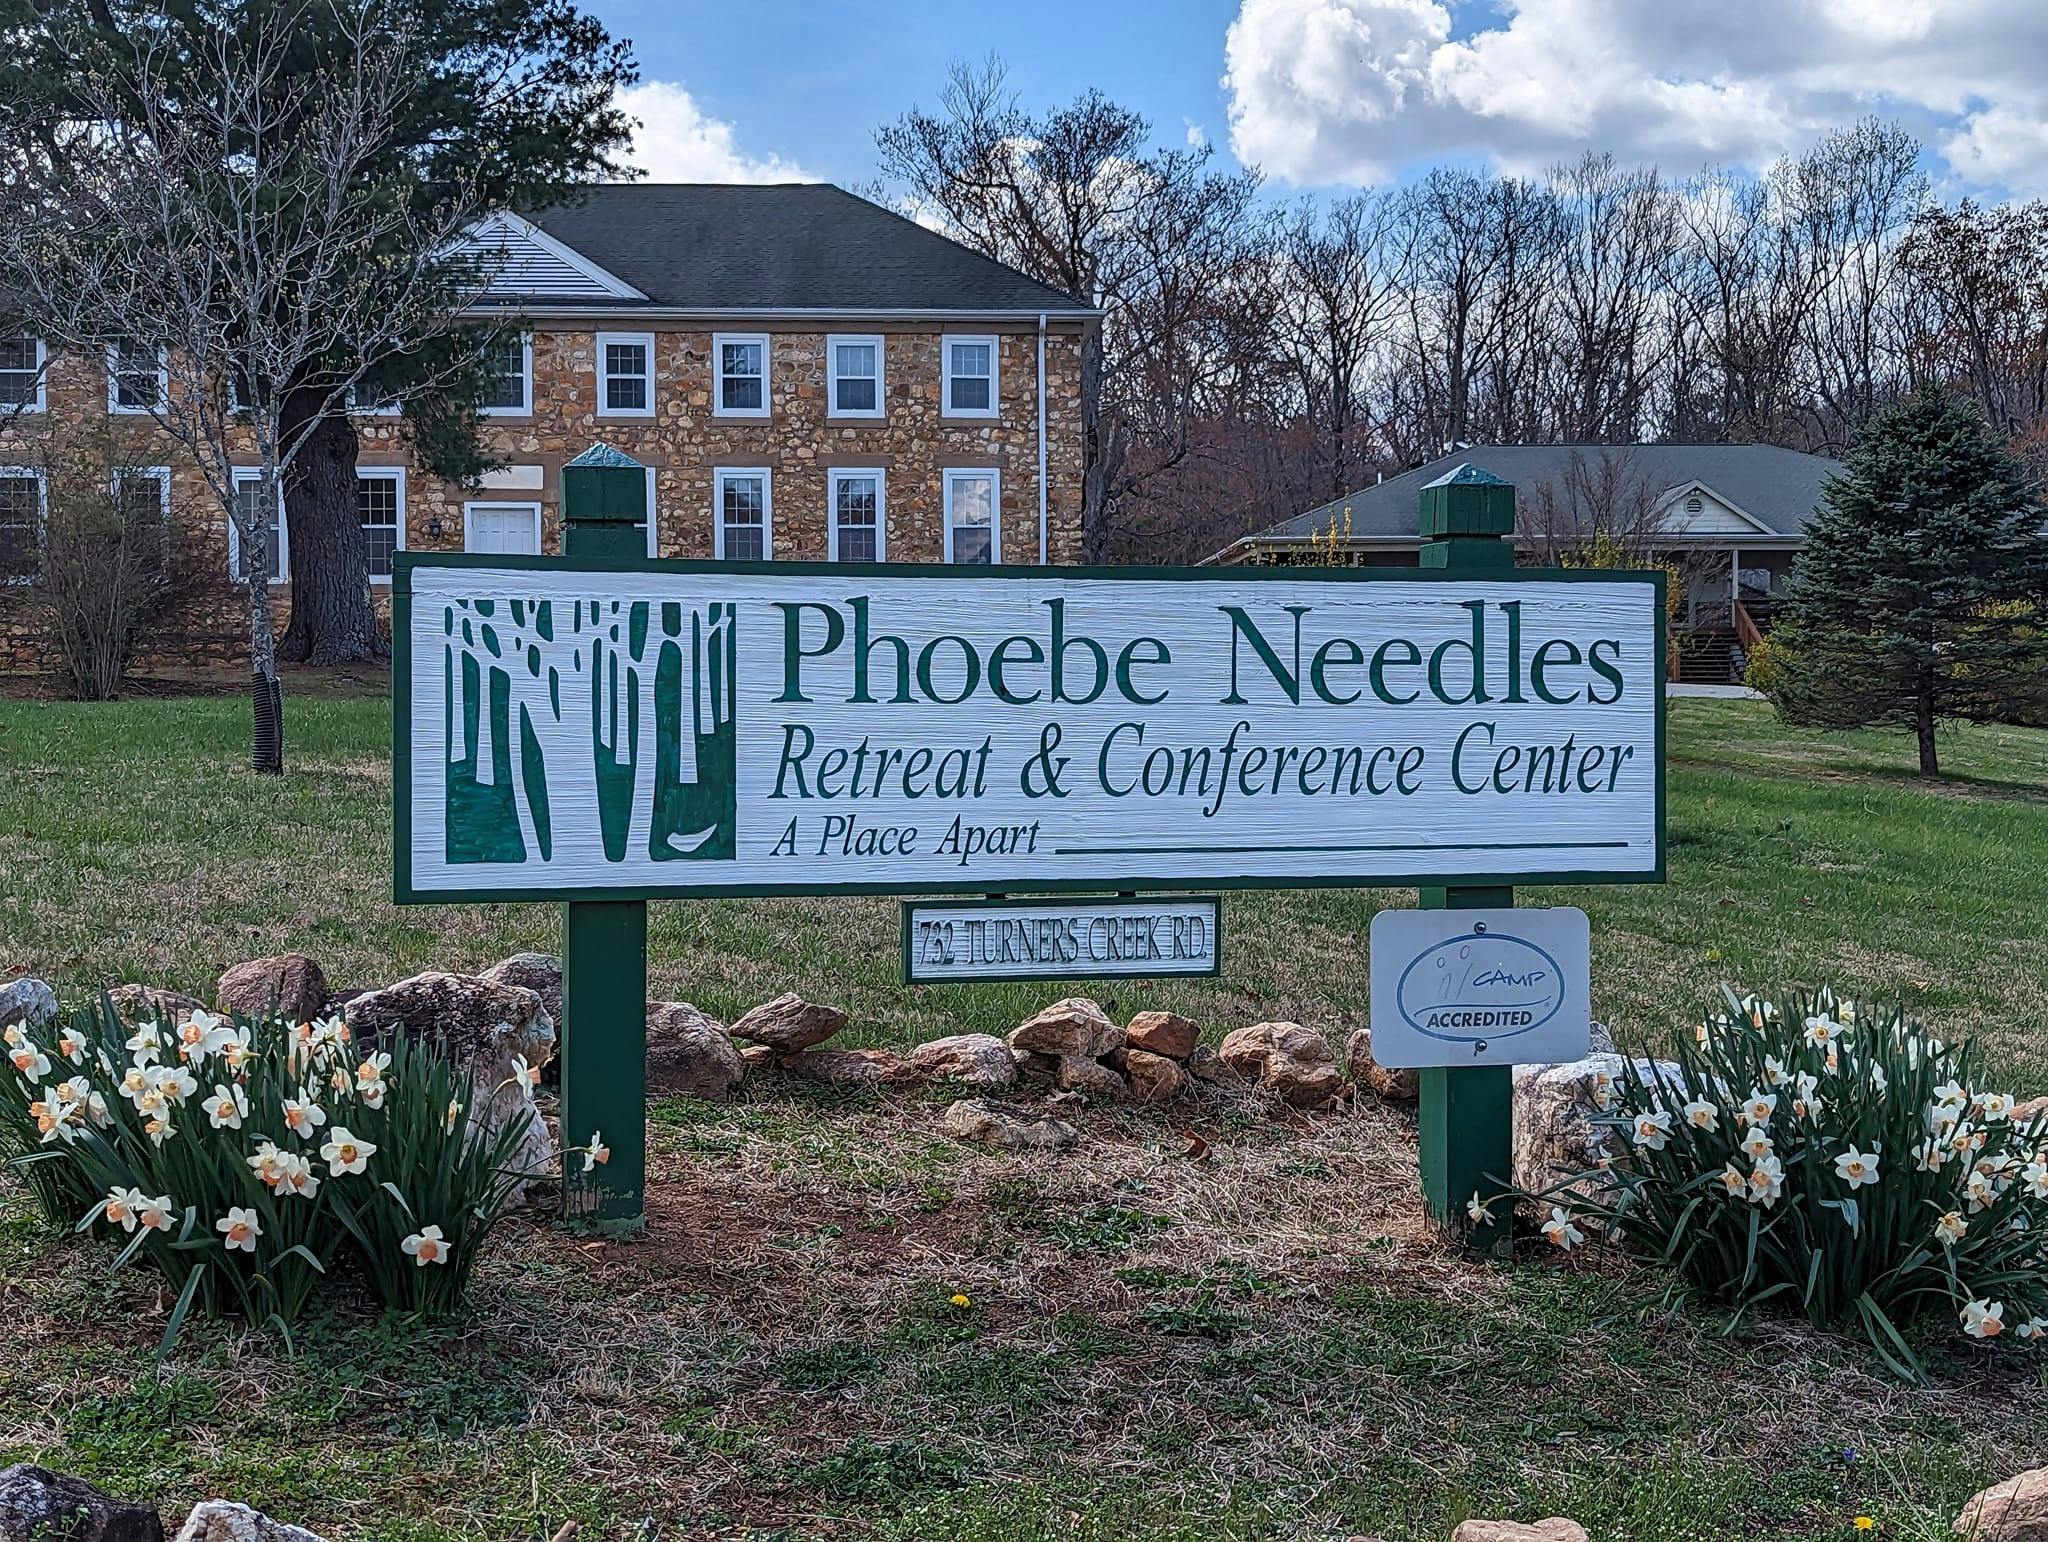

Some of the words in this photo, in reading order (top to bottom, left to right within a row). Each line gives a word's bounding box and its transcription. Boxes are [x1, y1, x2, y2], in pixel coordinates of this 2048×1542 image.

[769, 596, 1172, 706] Phoebe
[1218, 600, 1624, 706] Needles
[768, 724, 994, 800] Retreat
[1021, 723, 1073, 799] &
[1099, 722, 1425, 818] Conference
[1452, 722, 1634, 795] Center
[769, 816, 798, 857] A
[815, 815, 918, 857] Place
[933, 812, 1041, 867] Apart
[919, 920, 956, 966] 732
[965, 916, 1080, 964] TURNERS
[1087, 914, 1166, 961] CREEK
[1170, 914, 1208, 960] RD.
[1472, 968, 1546, 987] CAMP
[1426, 1010, 1533, 1029] ACCREDITED
